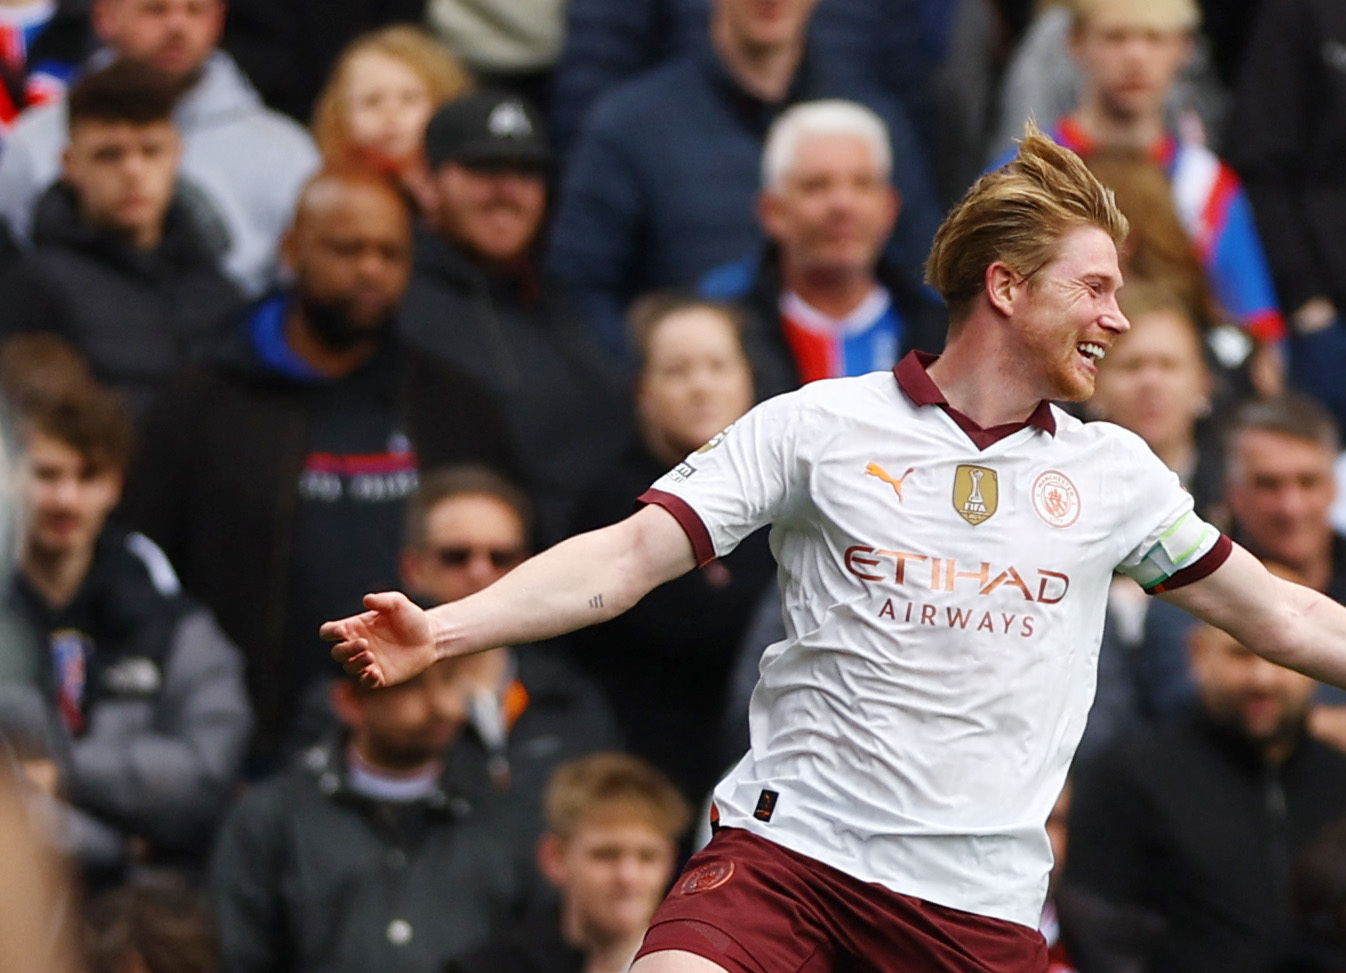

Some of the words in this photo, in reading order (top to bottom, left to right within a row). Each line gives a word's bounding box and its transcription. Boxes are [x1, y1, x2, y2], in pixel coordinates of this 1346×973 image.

[964, 502, 987, 512] FIFA
[844, 545, 1070, 605] ETIHAD
[878, 598, 1035, 638] AIRWAYS
